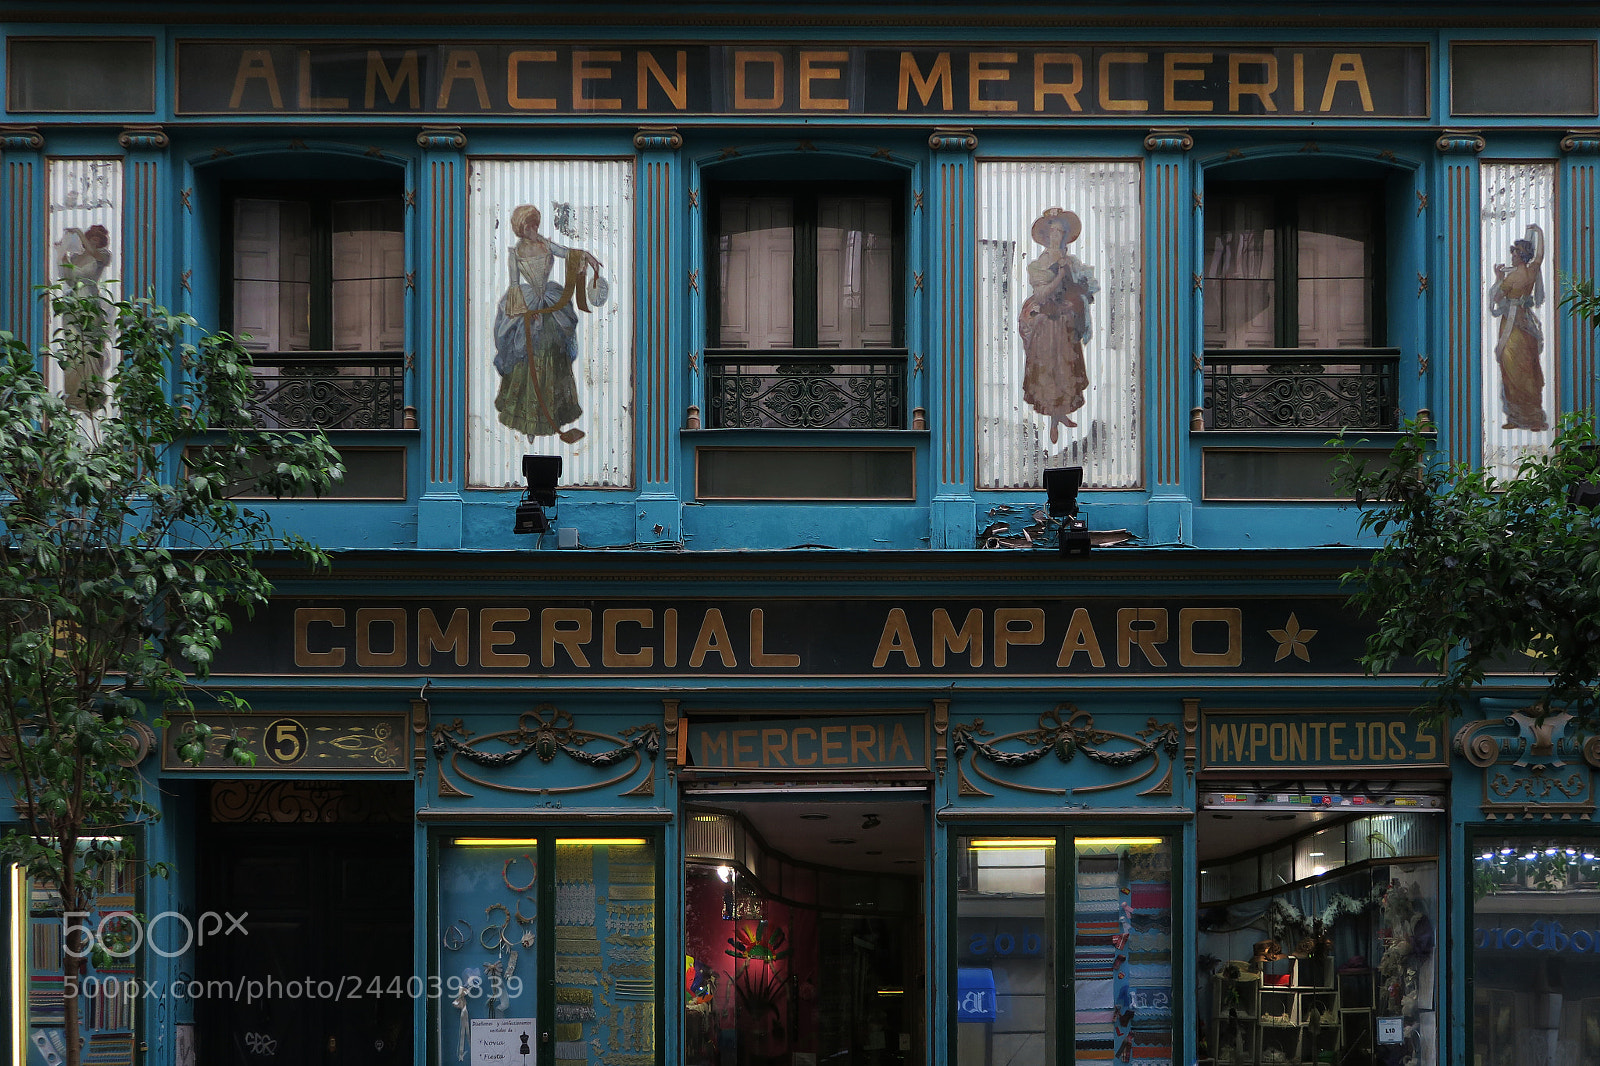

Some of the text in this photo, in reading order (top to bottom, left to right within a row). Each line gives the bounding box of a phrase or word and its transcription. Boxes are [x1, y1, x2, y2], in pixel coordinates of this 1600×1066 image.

[228, 49, 1375, 113] ALMACEN DE MERCERIA
[294, 607, 1242, 669] COMERCIAL AMPARO
[274, 725, 300, 761] 5
[700, 723, 914, 768] MERCERIA
